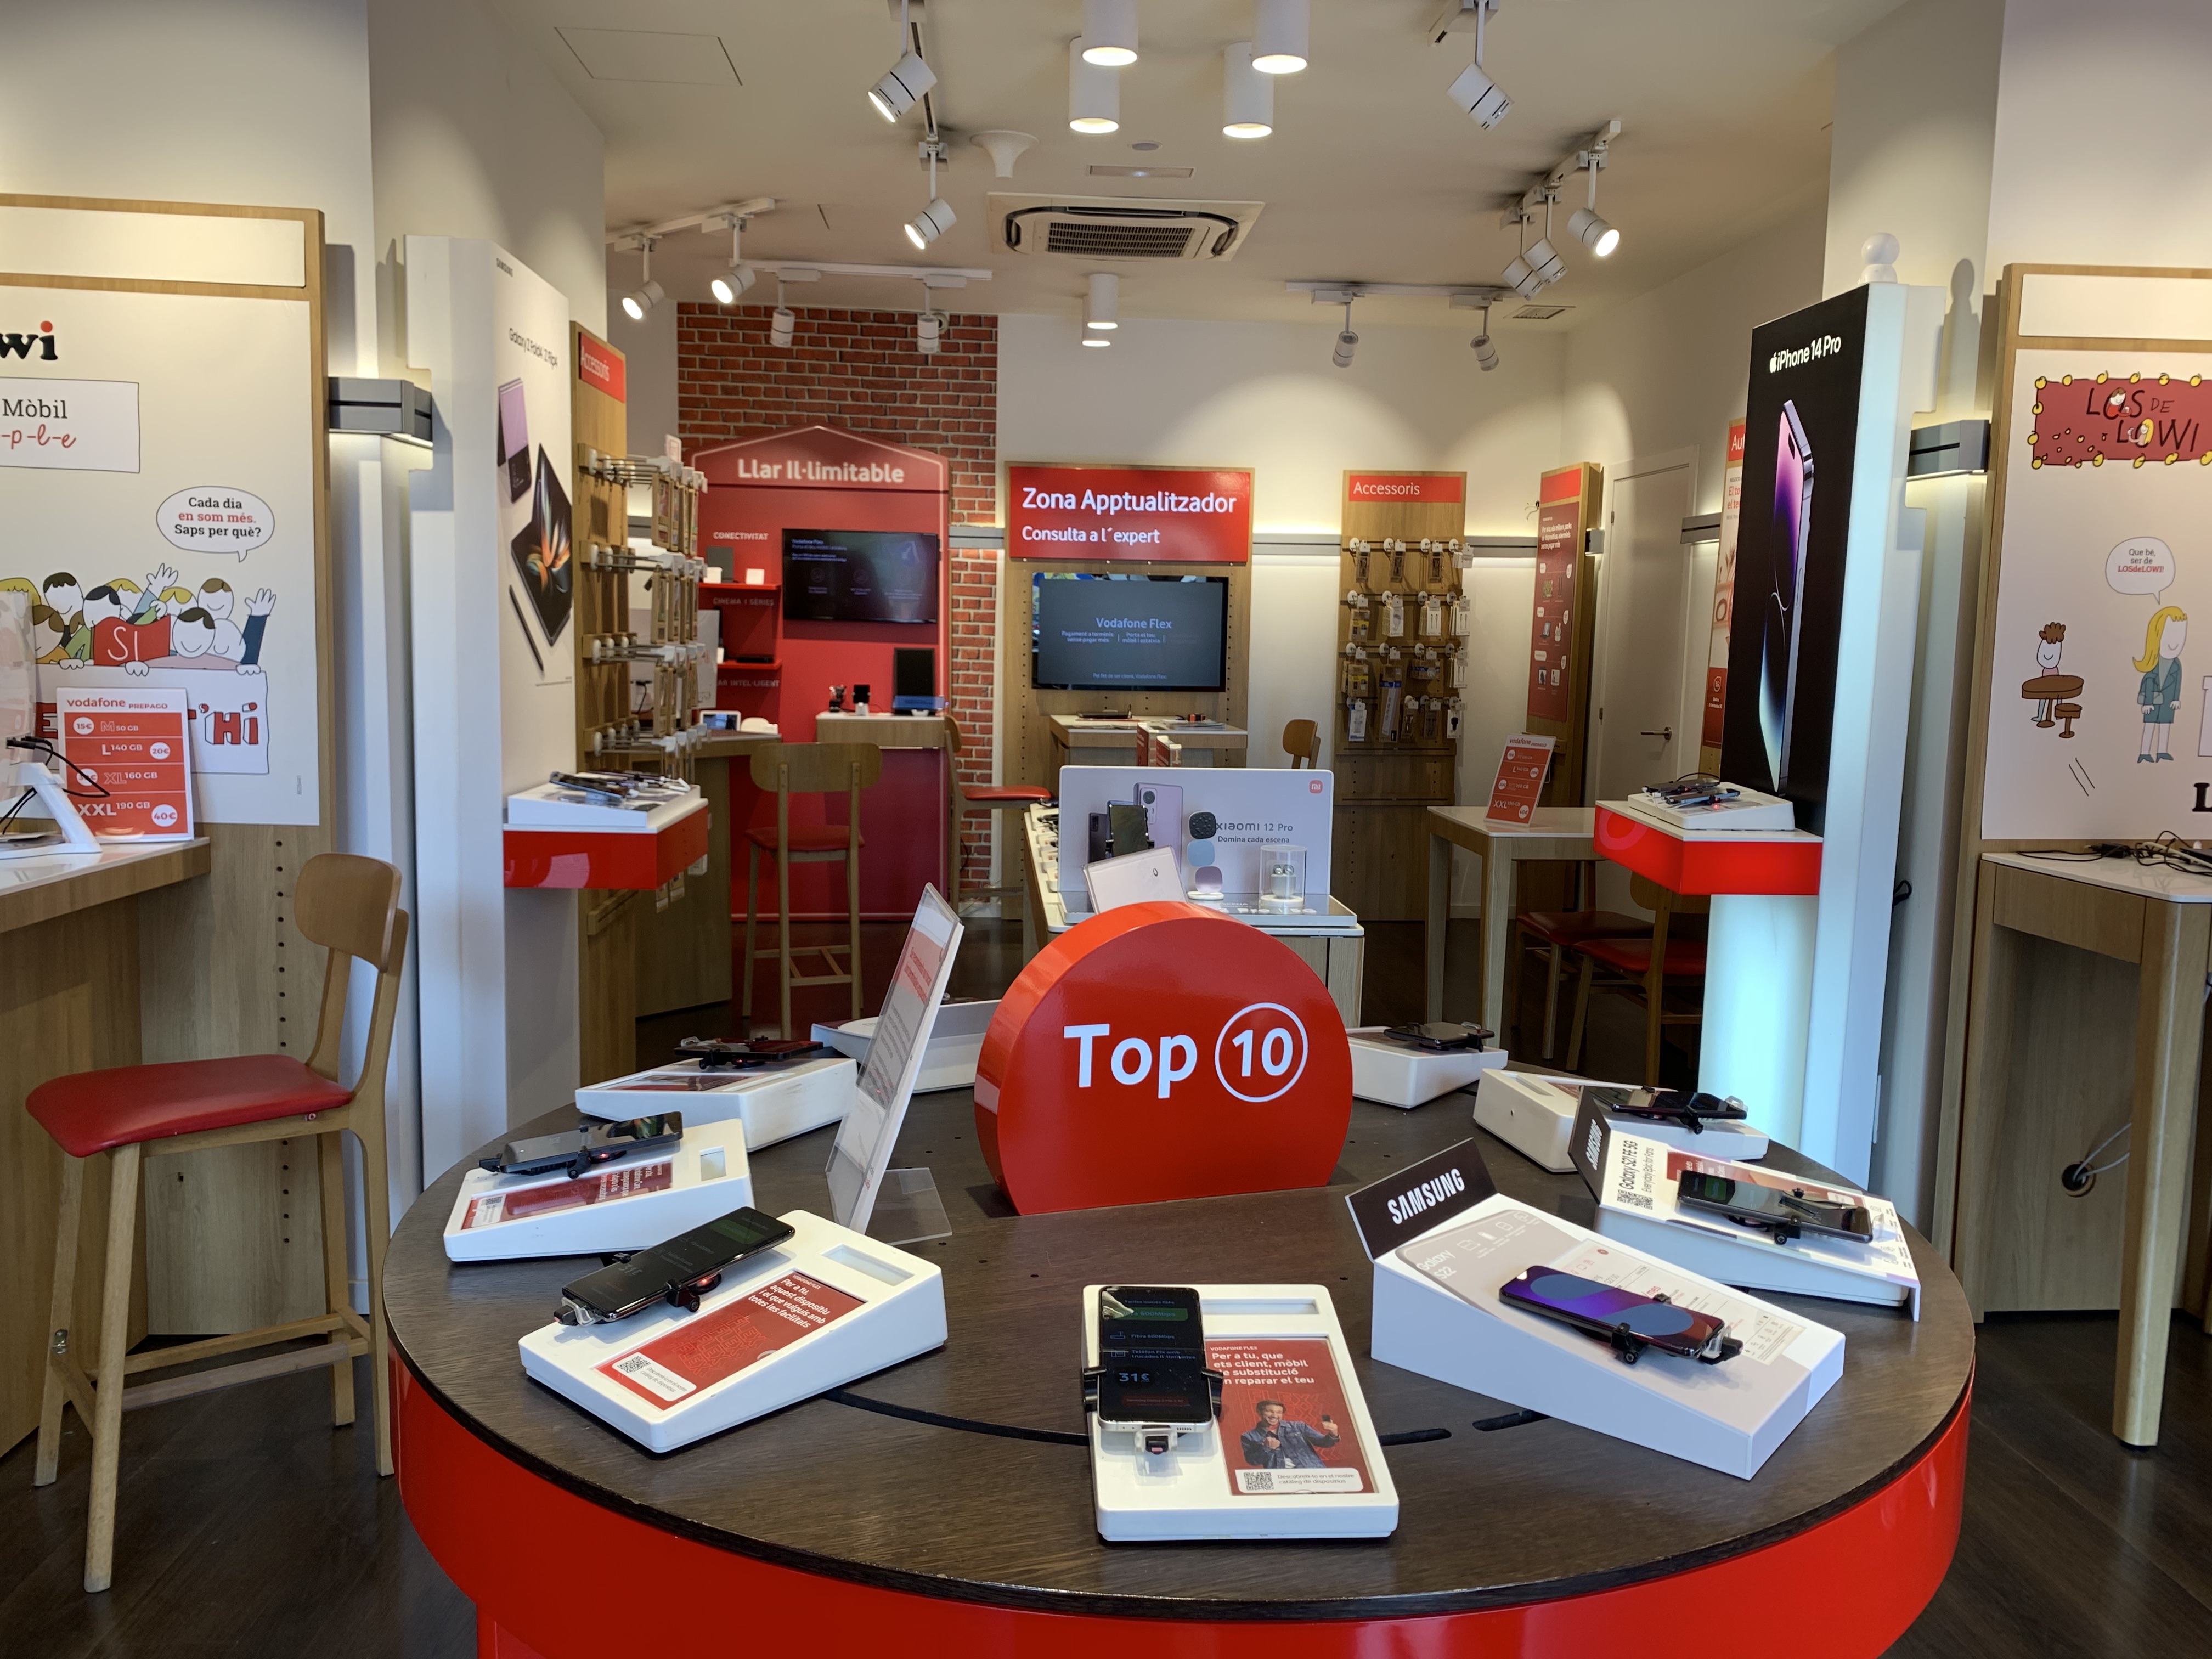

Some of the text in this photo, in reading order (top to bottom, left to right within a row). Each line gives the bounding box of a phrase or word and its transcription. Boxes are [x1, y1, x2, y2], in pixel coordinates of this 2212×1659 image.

[509, 327, 527, 353] Galaxy
[1776, 335, 1841, 371] iPhone 14 Pro
[580, 345, 610, 382] Accessoris
[2, 398, 68, 419] Mòbil
[2150, 398, 2175, 413] DE
[737, 458, 782, 479] Llar
[1353, 481, 1420, 496] Accessoris
[188, 496, 242, 509] Cada dia
[1022, 487, 1237, 516] Zona Apptualitzador
[178, 512, 256, 523] en som més.
[174, 524, 261, 539] Saps per què?
[713, 531, 769, 541] CONECTIVITAT
[1022, 526, 1087, 543] Consulta
[1089, 530, 1098, 543] a
[2145, 548, 2156, 557] bé,
[1096, 617, 1172, 629] Vodafone Flex
[106, 625, 139, 662] SI
[67, 697, 126, 708] vodafone
[100, 720, 115, 732] M
[101, 744, 111, 755] L
[104, 772, 127, 785] XL
[77, 803, 117, 816] XXL
[1493, 799, 1508, 809] XXL
[1216, 822, 1260, 831] xiaomi
[1278, 823, 1293, 832] Pro
[1063, 1023, 1294, 1099] Top 10
[1585, 1119, 1602, 1171] SAMSUNG
[1619, 1140, 1640, 1190] Galaxy S21 FE 5G
[1641, 1172, 1656, 1193] Everyday
[1387, 1168, 1465, 1224] SAMSUNG
[1415, 1250, 1456, 1272] Galaxy
[1434, 1266, 1457, 1280] S22
[781, 1278, 796, 1287] Per
[798, 1287, 809, 1295] tu,
[770, 1285, 830, 1316] aquest dispositiu
[748, 1295, 811, 1328] totes les facilitats
[769, 1294, 785, 1305] que
[783, 1301, 810, 1317] vulguis
[807, 1312, 826, 1324] amb
[1261, 1353, 1284, 1361] que
[1233, 1368, 1299, 1376] substitució
[1234, 1378, 1278, 1386] reparar
